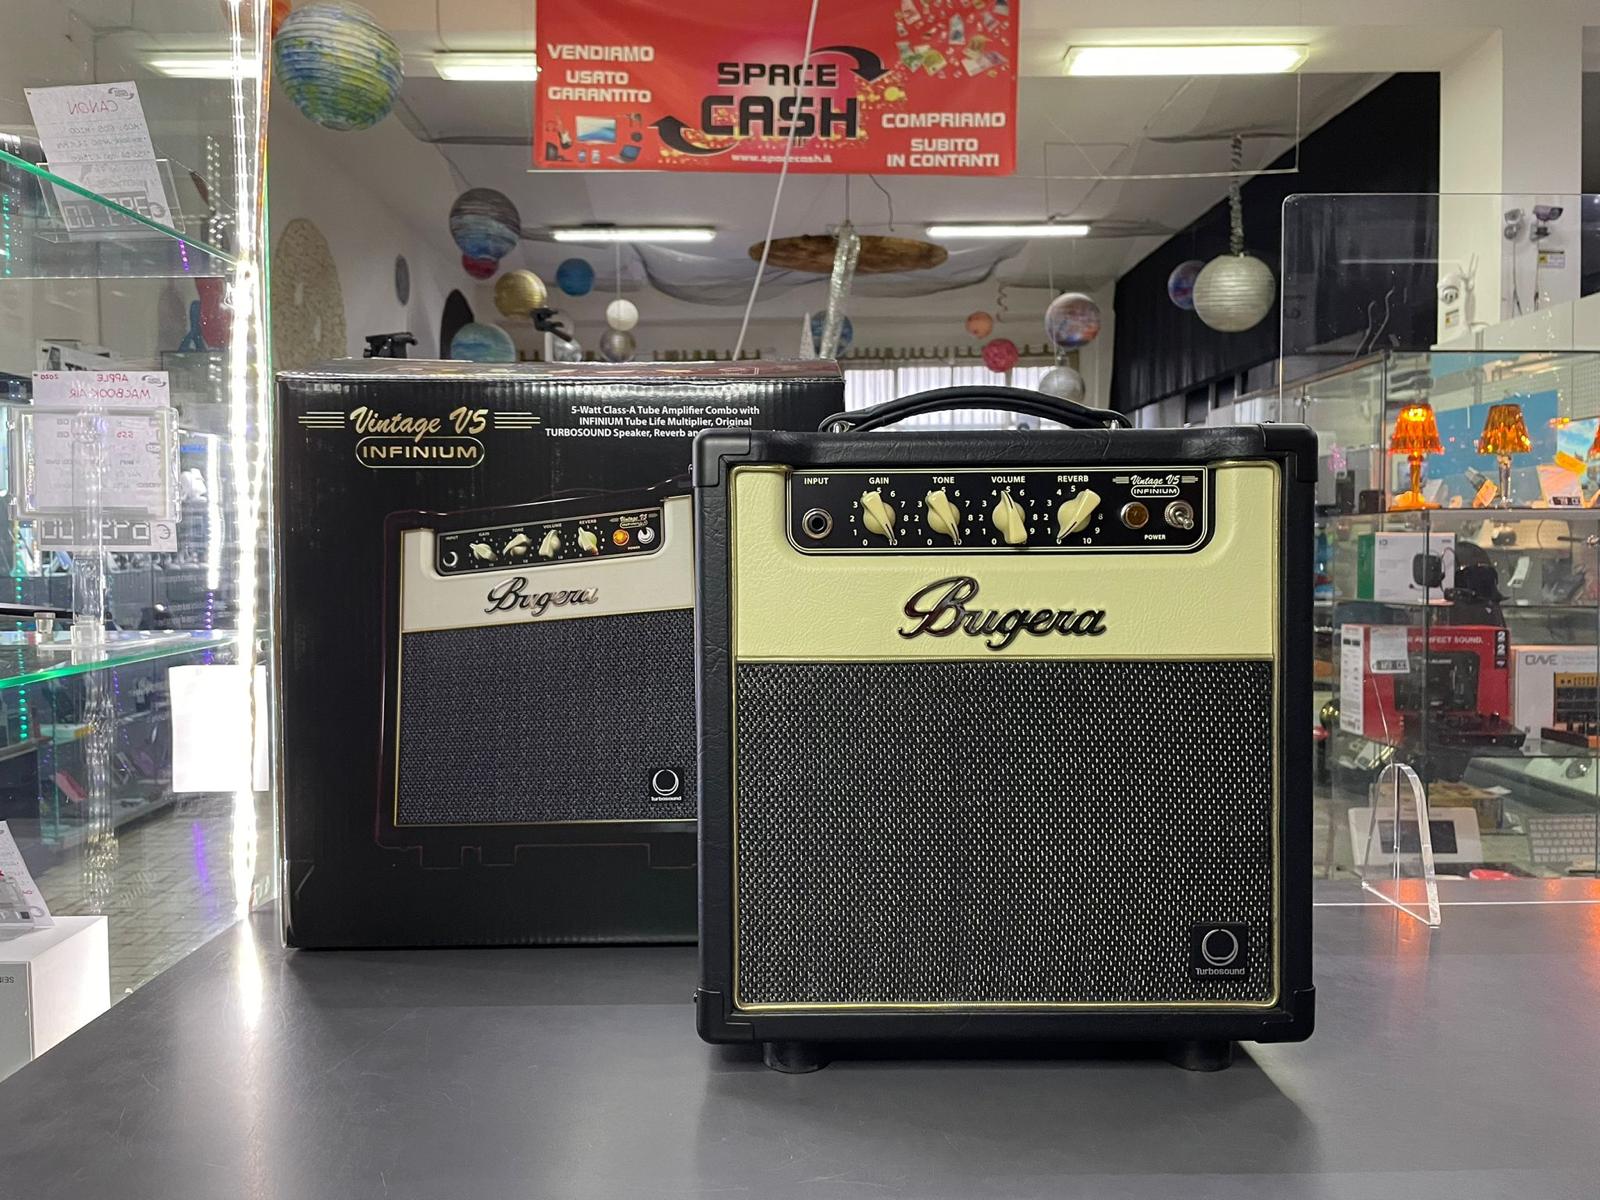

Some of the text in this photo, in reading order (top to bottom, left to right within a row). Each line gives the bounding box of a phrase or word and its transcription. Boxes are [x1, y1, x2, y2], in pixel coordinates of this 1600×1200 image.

[547, 43, 654, 62] VENDIAMO
[566, 70, 629, 85] USATO
[717, 62, 837, 87] SPACE
[548, 86, 652, 103] GARANTITO
[701, 95, 858, 139] CASH
[881, 112, 1006, 128] COMPRIAMO
[910, 138, 979, 152] SUBITO
[886, 153, 1000, 168] IN CONTANTI
[571, 406, 760, 416] 5-Watt Class-A Tube Amplifier Combo with
[350, 406, 488, 442] Vintage V5
[580, 417, 752, 428] INFINIUM Tube Life Multiplier, Original
[544, 428, 612, 436] TURBOSOUND
[613, 428, 652, 438] Speaker,
[654, 428, 686, 437] Reverb
[363, 446, 477, 459] INFINIUM
[804, 477, 828, 485] INPUT
[868, 476, 890, 484] GAIN
[932, 476, 955, 484] TONE
[1130, 474, 1180, 488] Vintage V5
[484, 576, 599, 617] Bugera
[898, 576, 1107, 651] Bugera
